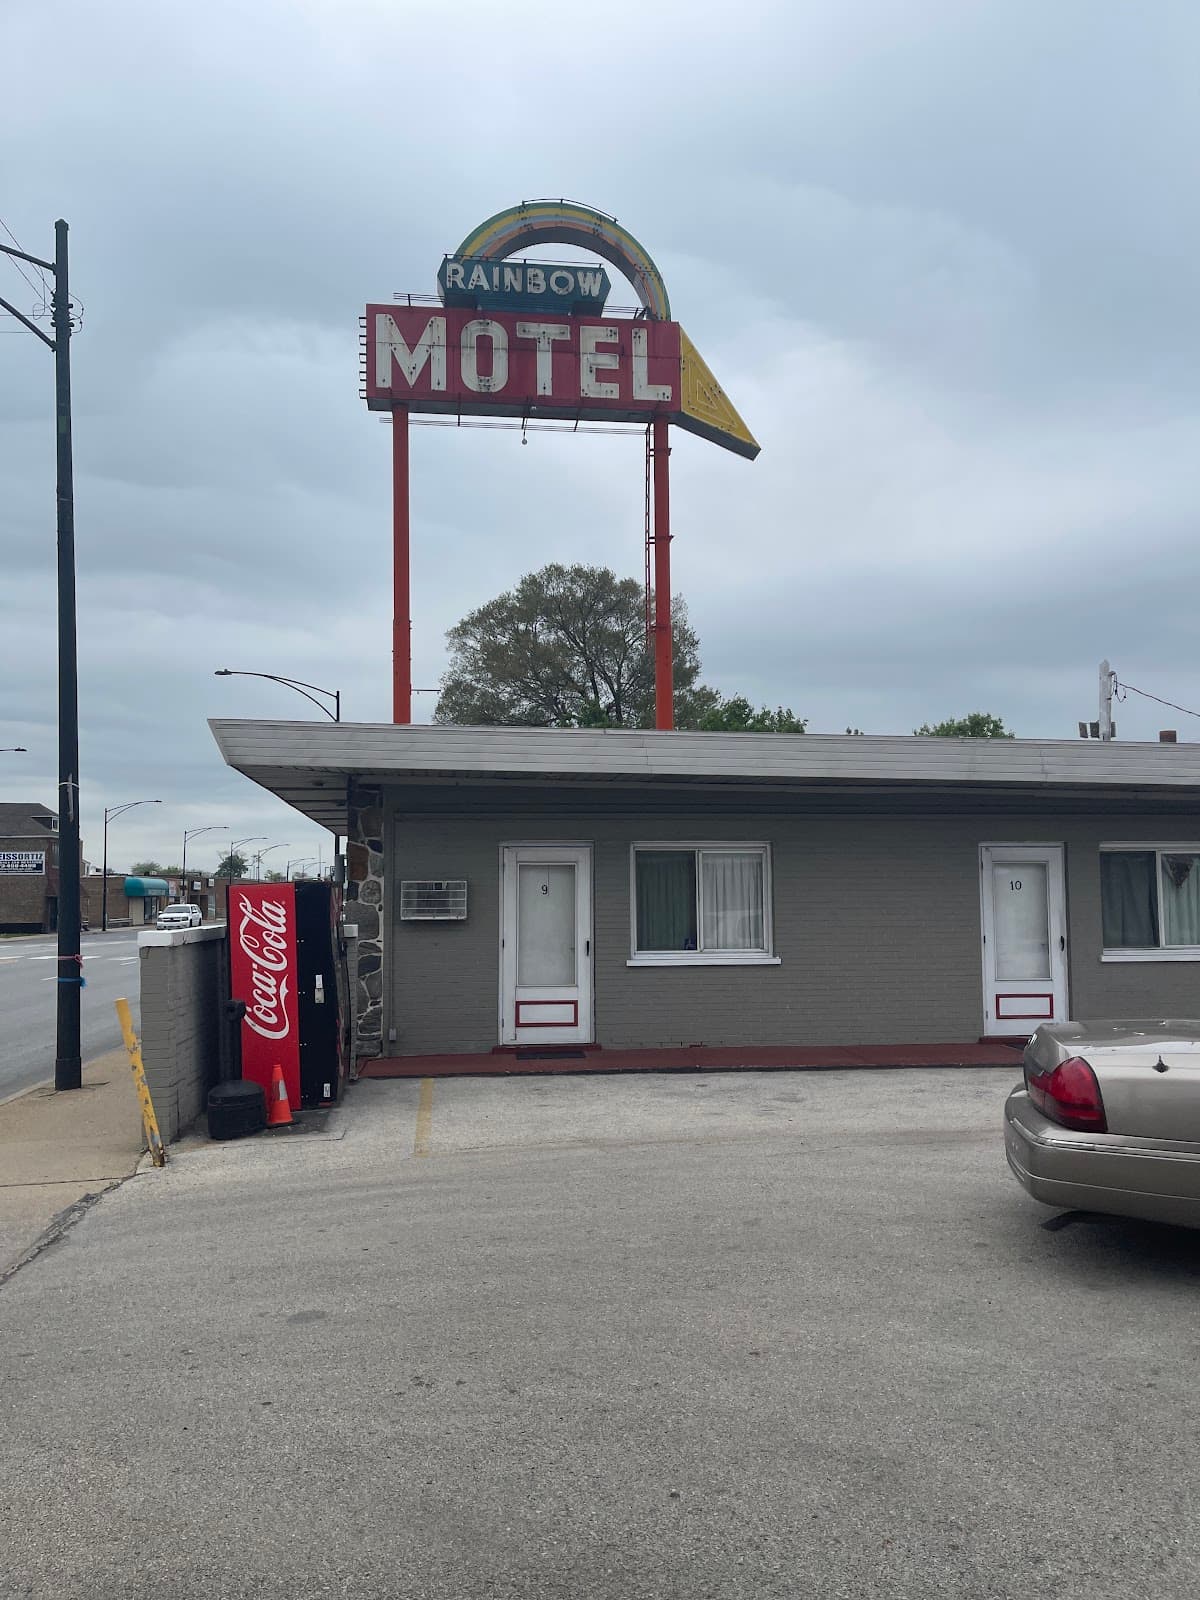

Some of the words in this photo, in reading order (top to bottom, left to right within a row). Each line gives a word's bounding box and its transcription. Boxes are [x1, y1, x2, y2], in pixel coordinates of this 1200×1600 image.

[446, 263, 603, 297] RAINBOW
[375, 313, 672, 402] MOTEL
[541, 884, 548, 895] 9
[1010, 880, 1022, 891] 10
